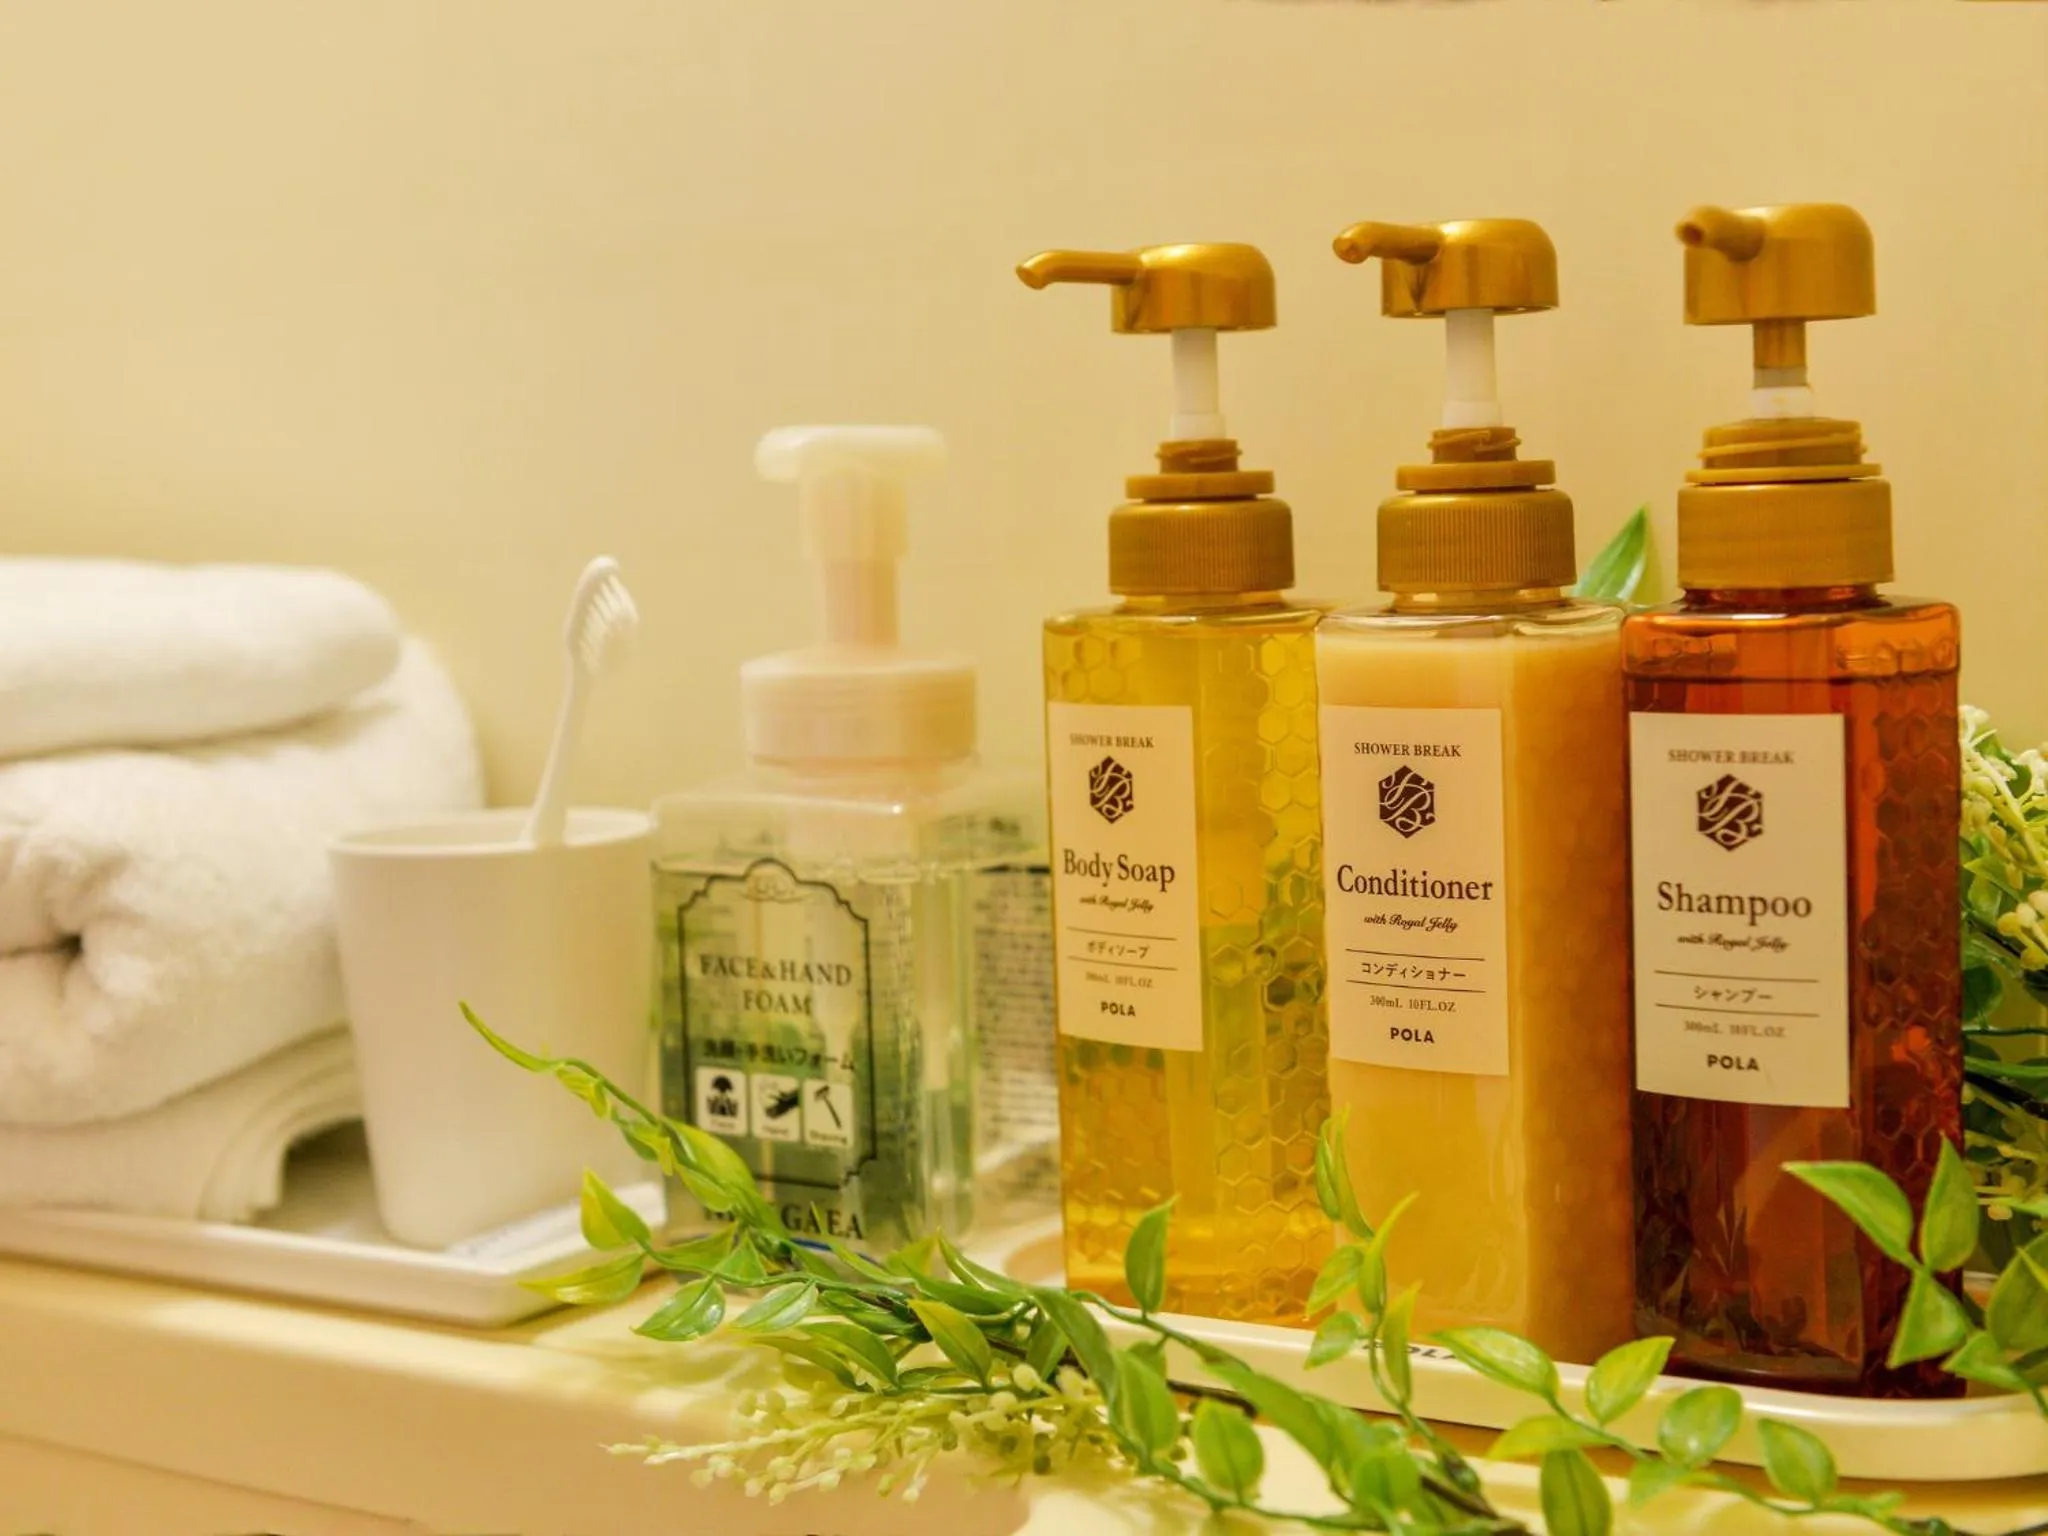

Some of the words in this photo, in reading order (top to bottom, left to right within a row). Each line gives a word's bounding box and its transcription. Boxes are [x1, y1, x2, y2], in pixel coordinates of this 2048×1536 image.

[1070, 733, 1113, 747] SHOWER
[1116, 735, 1154, 749] BREAK
[1354, 742, 1411, 757] SHOWER
[1413, 744, 1462, 758] BREAK
[1668, 749, 1737, 764] SHOWER
[1739, 750, 1795, 765] BREAK
[1063, 848, 1113, 887] Body
[1118, 854, 1175, 892] Soap
[1336, 864, 1492, 901] Conditioner
[1657, 881, 1812, 926] Shampoo
[1363, 913, 1387, 925] with
[1389, 913, 1427, 930] Royal
[1425, 917, 1458, 934] Jelly
[1361, 962, 1466, 980] コンディショナー
[744, 989, 812, 1016] FOAM
[1101, 1001, 1136, 1016] POLA
[1390, 1027, 1435, 1044] POLA
[1707, 1054, 1760, 1071] POLA
